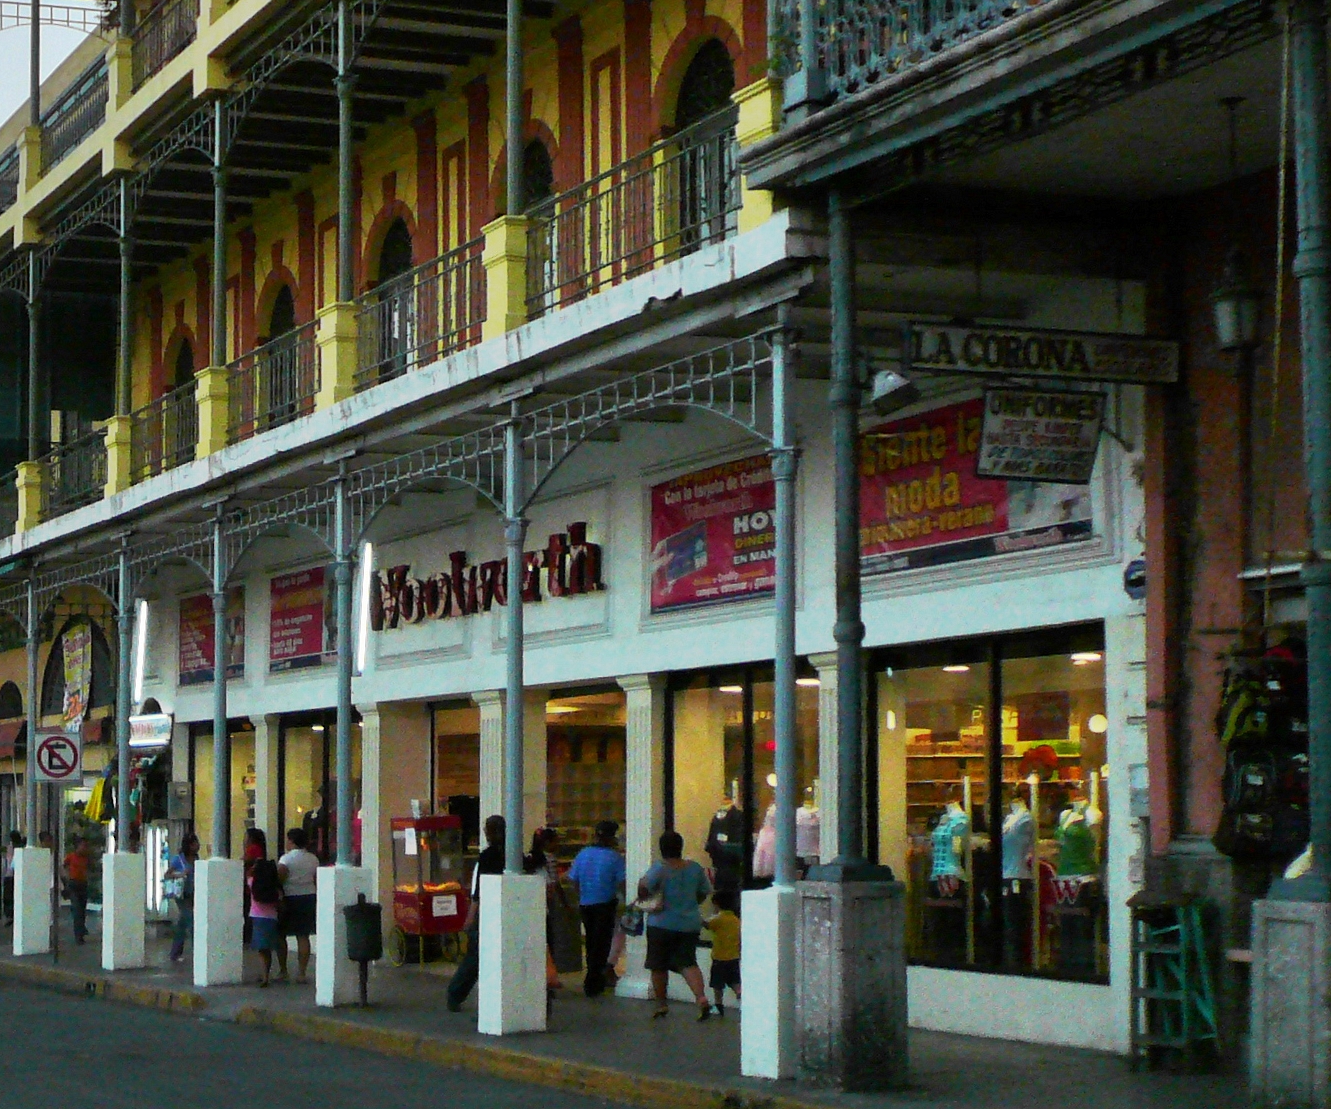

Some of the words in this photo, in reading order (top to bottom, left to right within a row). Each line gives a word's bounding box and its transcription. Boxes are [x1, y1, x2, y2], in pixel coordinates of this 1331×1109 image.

[912, 330, 955, 365] LA
[962, 332, 1091, 373] CORONA
[370, 521, 607, 631] Woolworth
